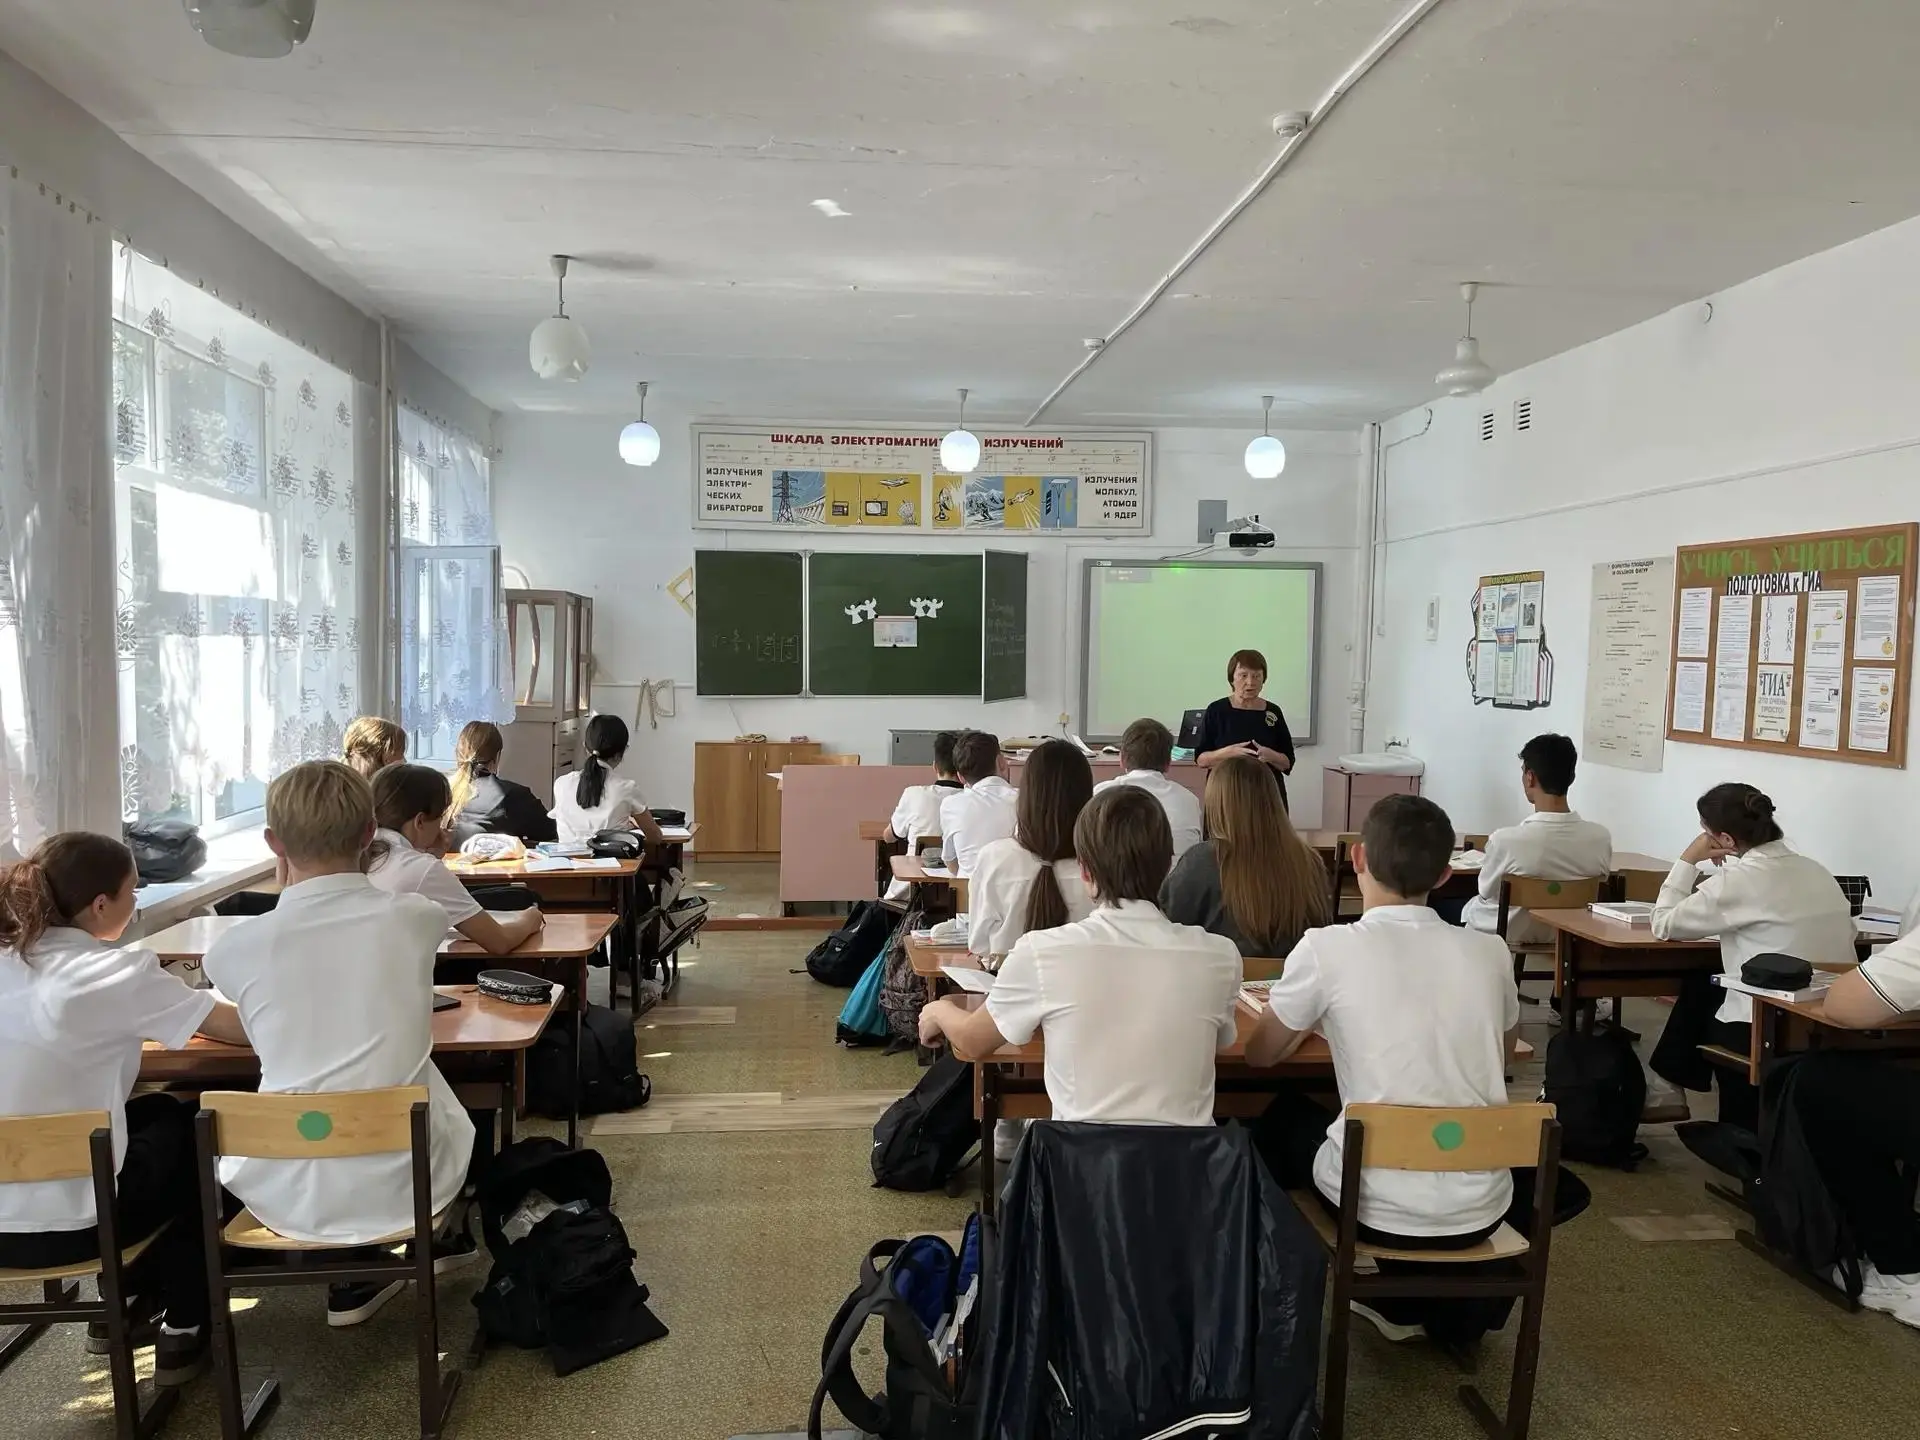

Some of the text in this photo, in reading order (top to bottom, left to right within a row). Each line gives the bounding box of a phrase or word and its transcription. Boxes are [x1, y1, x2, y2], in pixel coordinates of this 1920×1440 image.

[771, 433, 1064, 449] ШКАЛА ЭЛЕКТРОМАГНИ ИЗЛУЧЕНИЙ
[706, 467, 763, 477] ИЗЛУЧЕНИЯ
[706, 479, 752, 488] ЭЛЕКТРИ-
[1084, 476, 1138, 484] ИЗЛУЧЕНИЯ
[706, 491, 742, 500] ЧЕСКИХ
[1095, 488, 1138, 497] МОЛЕКУЛ,
[706, 504, 764, 513] ВИБРАТОРОВ
[1103, 500, 1138, 508] АТОМОВ
[1104, 511, 1138, 520] И ЯДЕР
[1681, 534, 1904, 578] УЧИСЬ УЧИТЬСЯ
[1727, 573, 1790, 596] ПОДГОТОВКА
[1801, 571, 1822, 592] ГИА
[1762, 673, 1785, 696] ГИА
